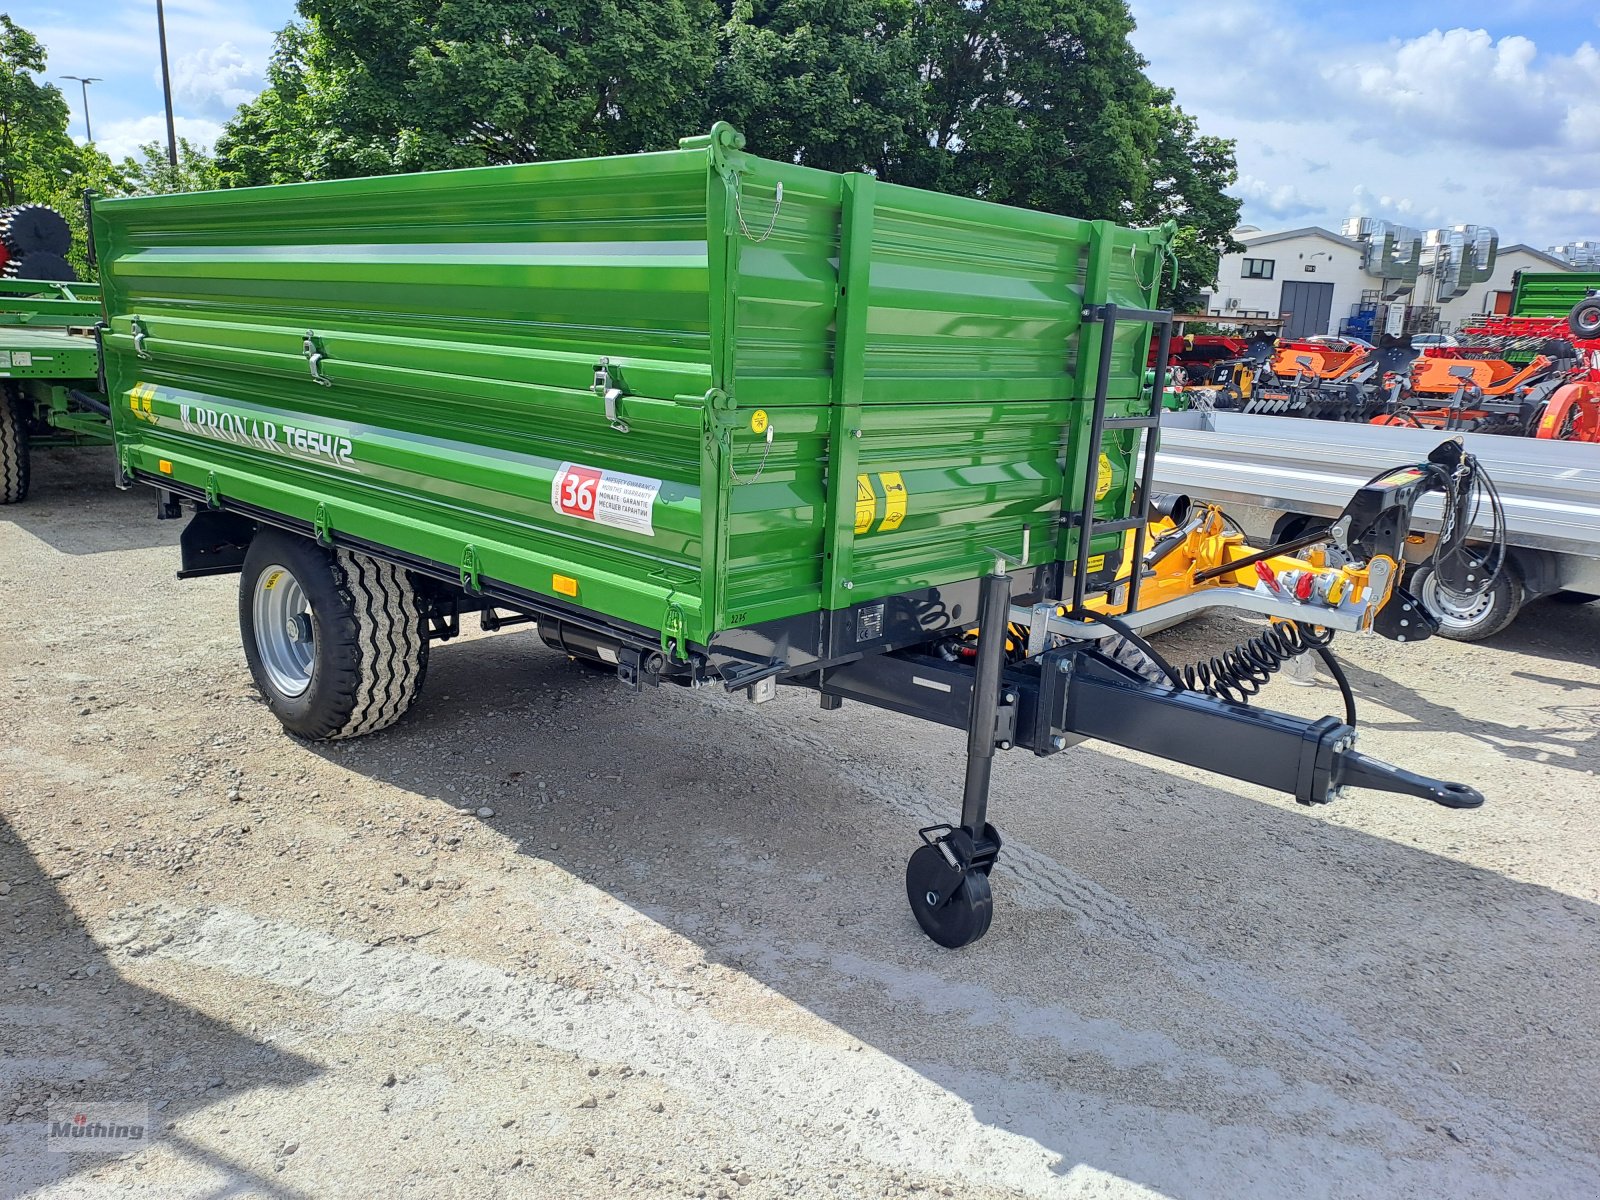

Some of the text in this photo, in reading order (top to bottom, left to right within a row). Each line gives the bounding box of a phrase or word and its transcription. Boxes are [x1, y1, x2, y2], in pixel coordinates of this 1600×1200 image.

[196, 407, 355, 464] PRONAR T654/2
[562, 474, 596, 511] 36
[599, 492, 649, 508] MONATE GARANTIE
[602, 484, 652, 499] MONTHS WARRANTY
